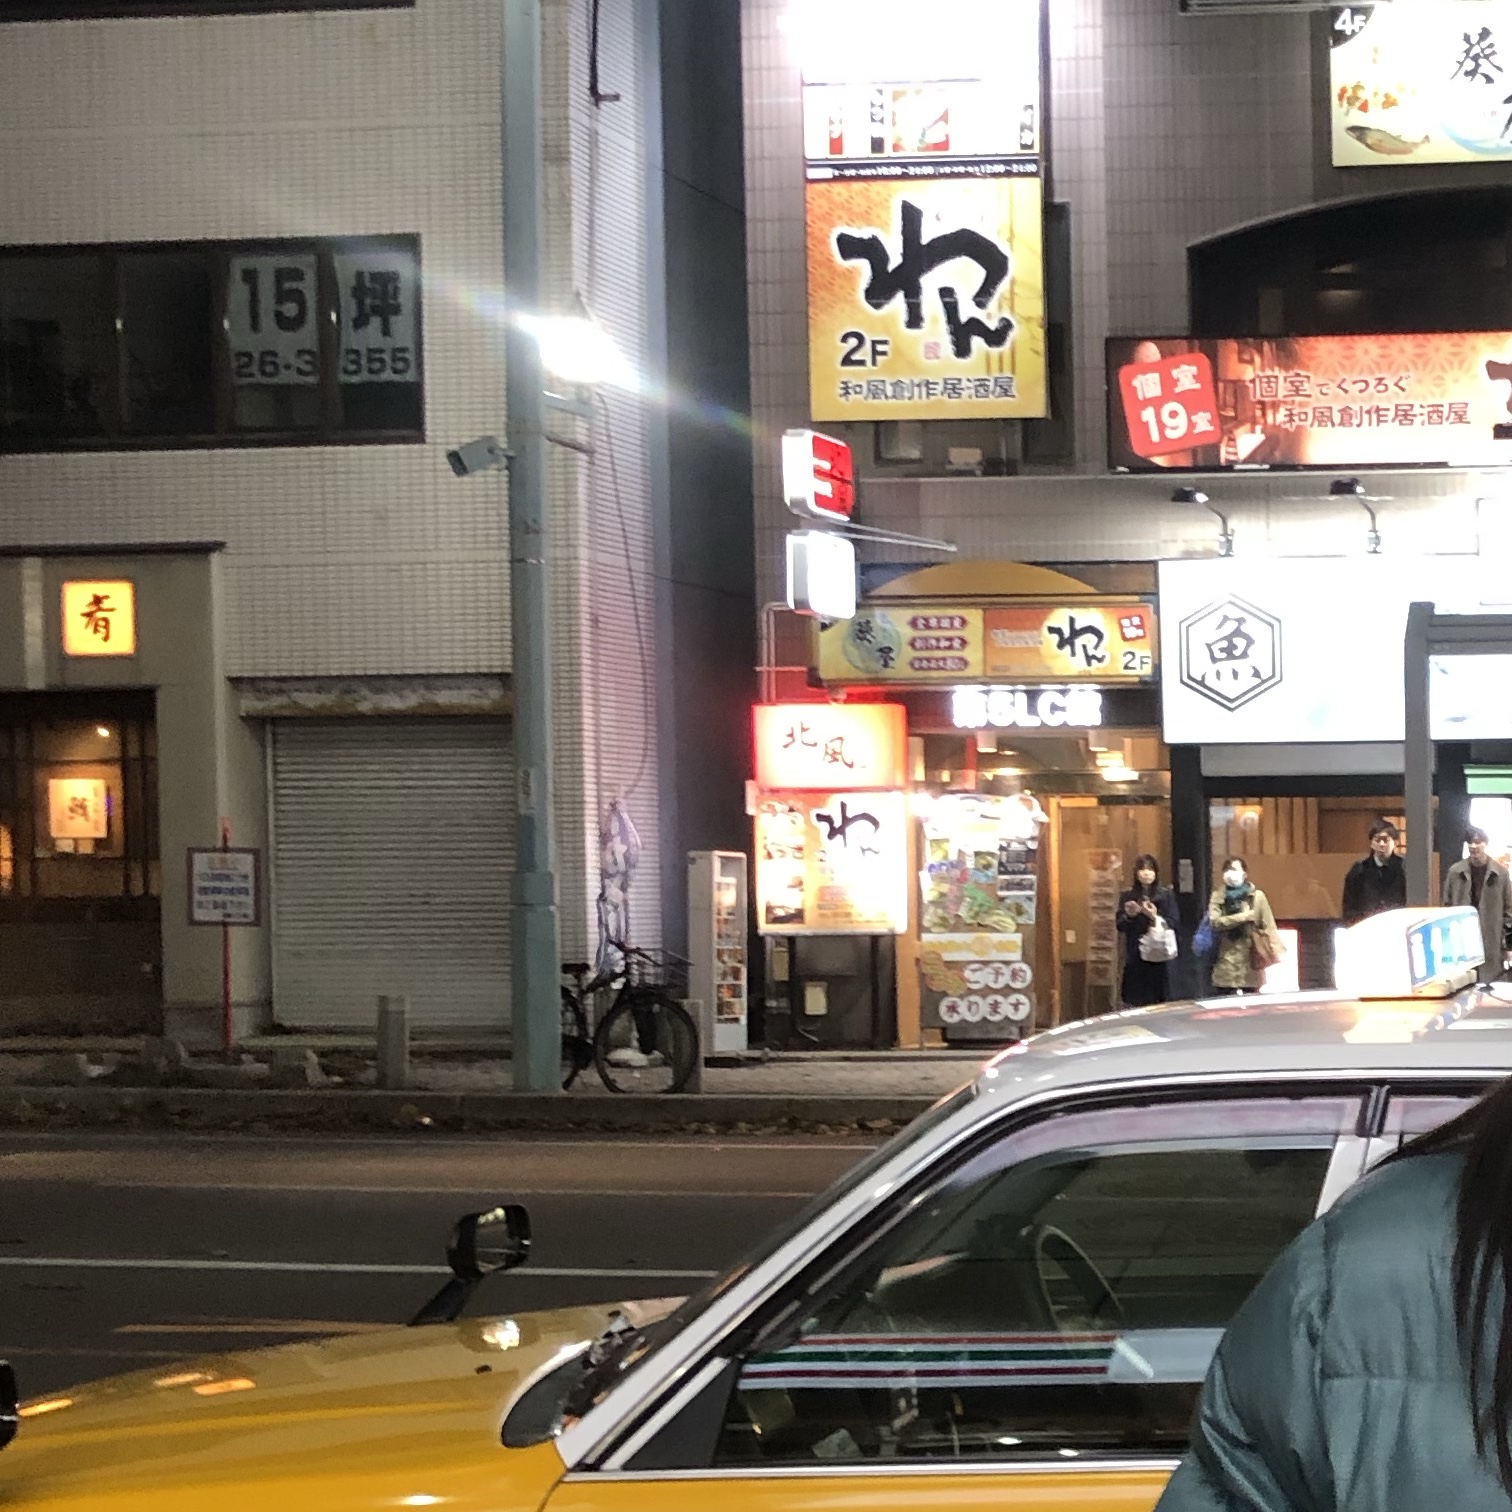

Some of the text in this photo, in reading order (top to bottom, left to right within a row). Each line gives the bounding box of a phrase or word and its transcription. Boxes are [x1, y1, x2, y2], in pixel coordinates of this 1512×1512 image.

[1334, 8, 1366, 35] 4F
[836, 200, 1014, 359] わん
[242, 267, 401, 337] 15 坪
[839, 331, 889, 367] 2F
[839, 376, 1016, 402] 和風創作居酒屋
[1132, 364, 1201, 400] 個室
[1252, 372, 1410, 400] 個室でくつろぐ
[1141, 401, 1216, 443] 19室
[1282, 403, 1472, 429] 和風創作居酒屋
[1047, 615, 1106, 667] わん
[1201, 614, 1263, 684] 魚
[1123, 651, 1152, 670] 2F
[783, 721, 854, 768] 北風
